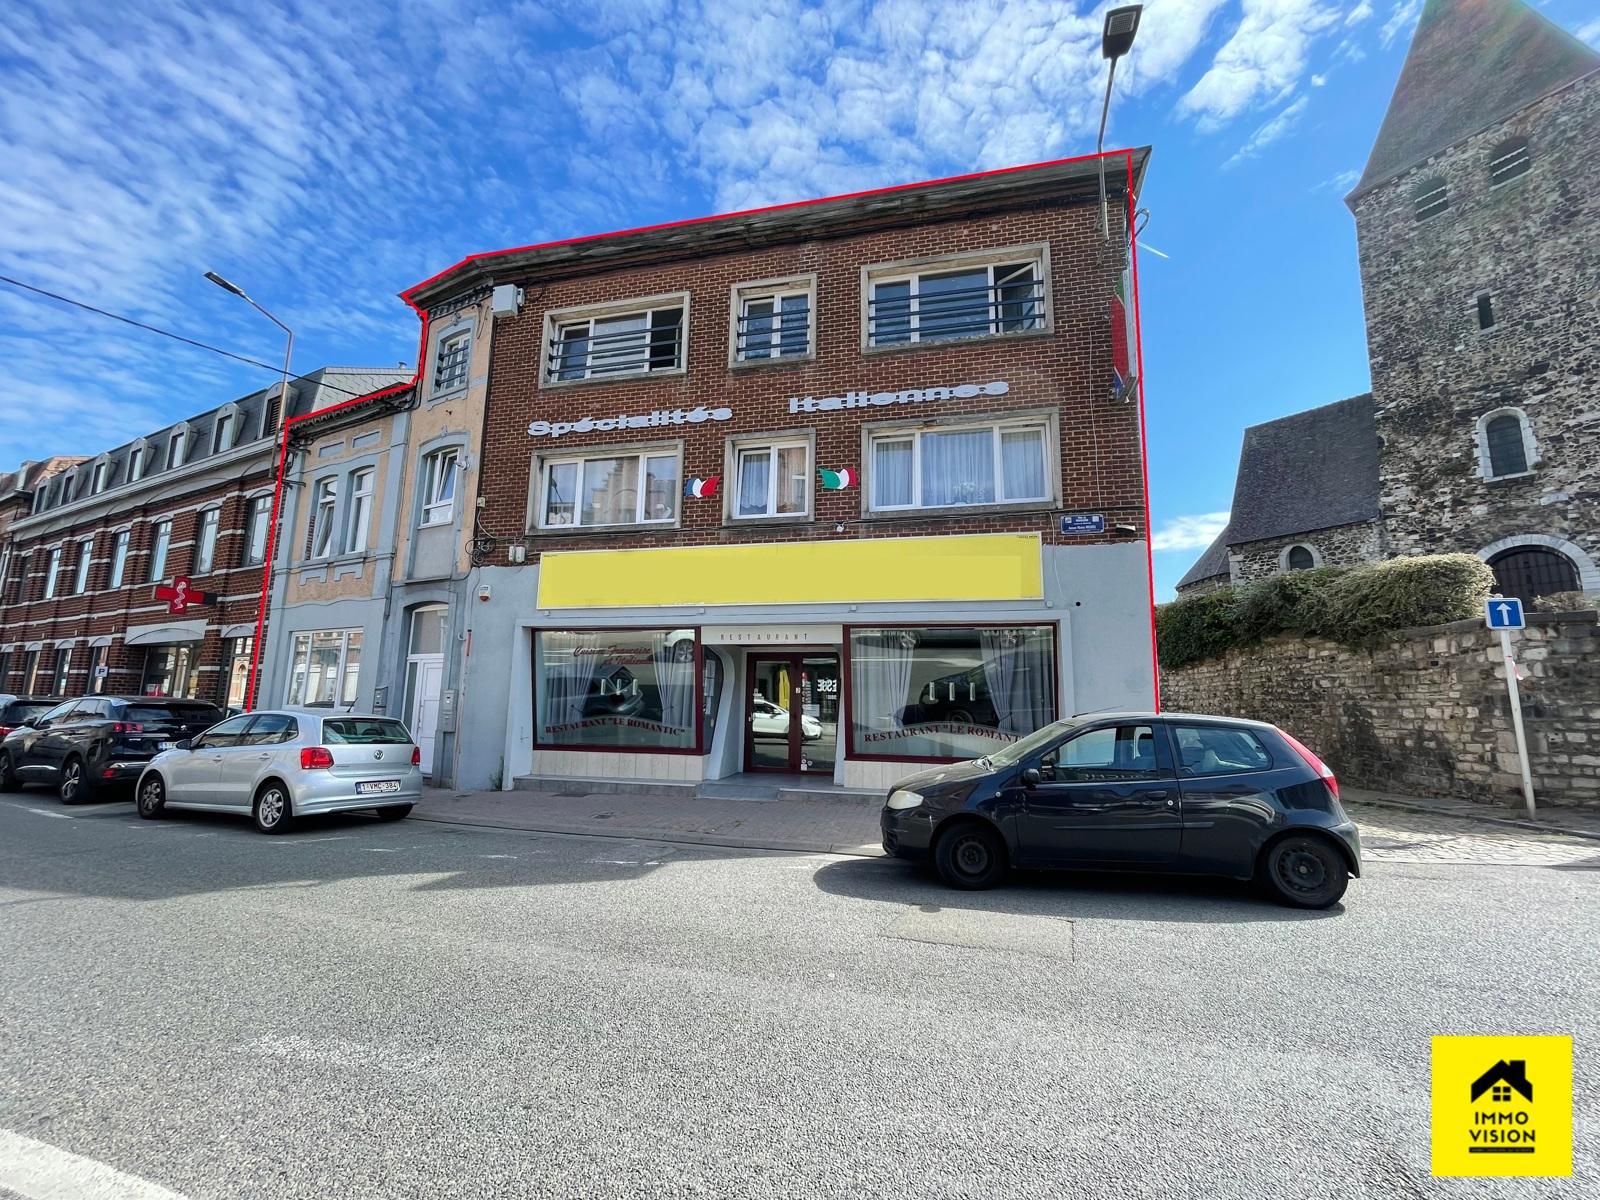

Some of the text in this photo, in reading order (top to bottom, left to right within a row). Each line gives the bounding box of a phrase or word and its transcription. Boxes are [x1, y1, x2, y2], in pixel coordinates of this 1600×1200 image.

[720, 633, 808, 641] RESTAURANT
[545, 718, 605, 734] RESTAURANT
[864, 725, 941, 742] RESTAURANT
